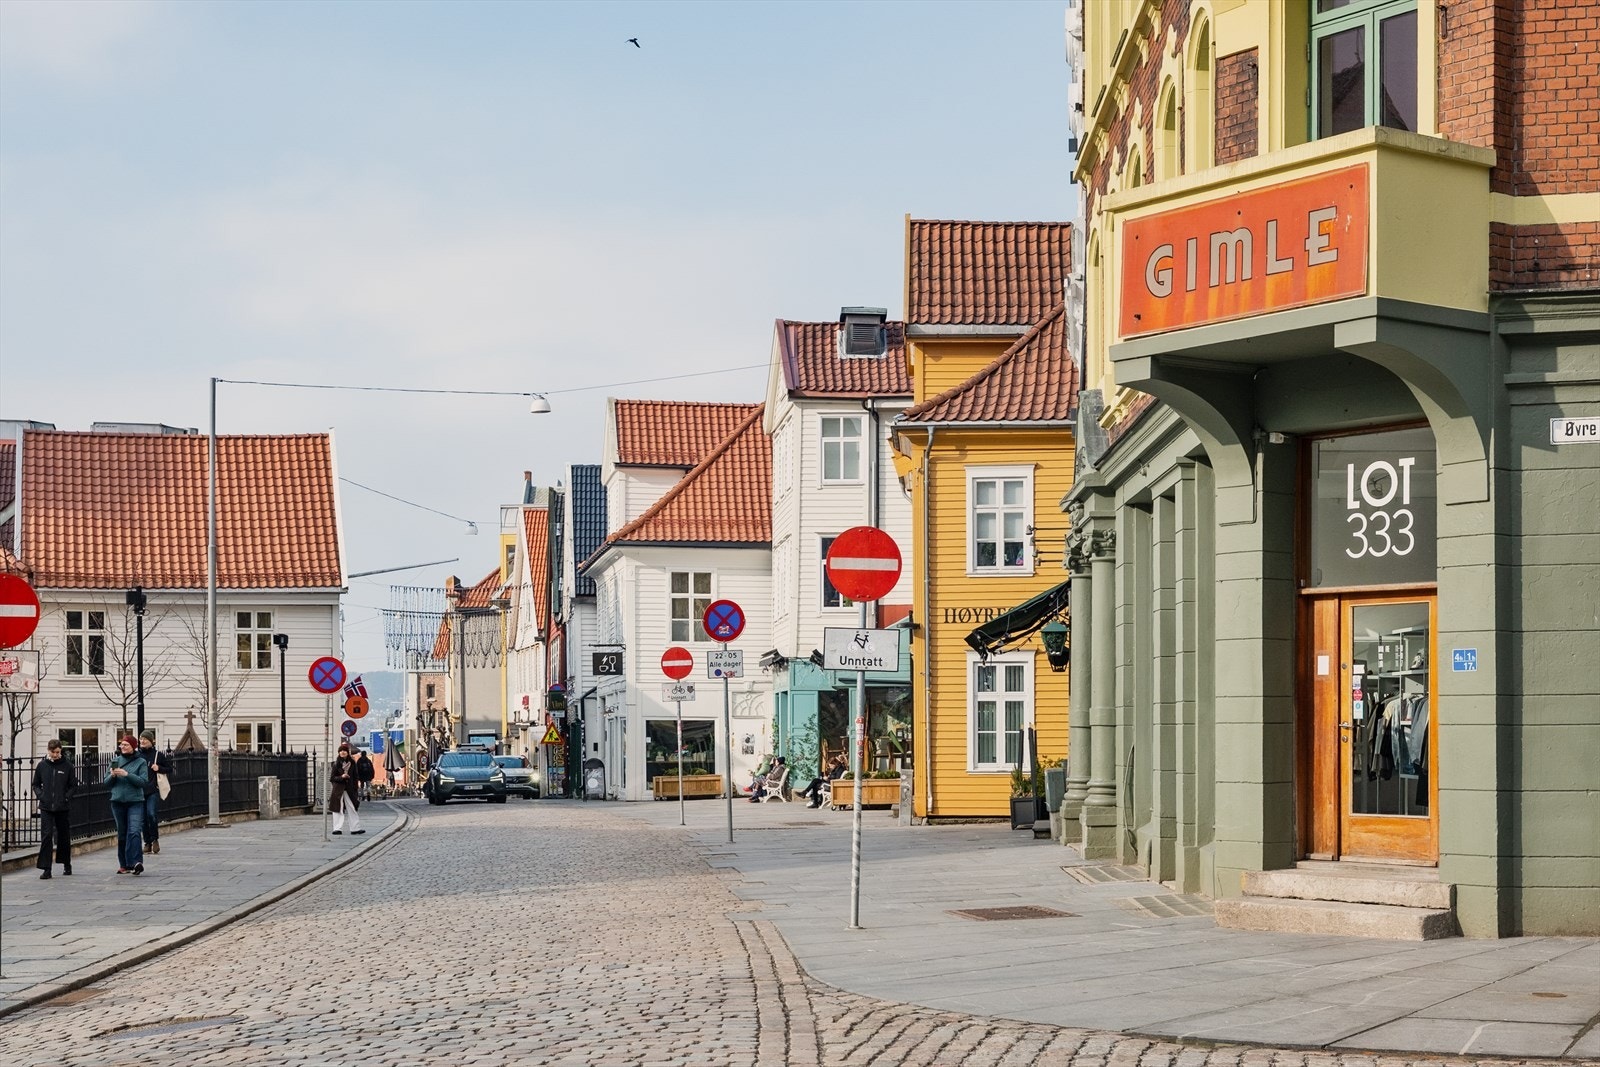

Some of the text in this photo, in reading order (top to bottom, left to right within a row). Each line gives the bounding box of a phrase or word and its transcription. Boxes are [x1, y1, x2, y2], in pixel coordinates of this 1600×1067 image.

[1145, 205, 1338, 298] GIMLE
[1565, 421, 1597, 436] Øvre
[1347, 457, 1415, 509] LOT
[1345, 508, 1415, 559] 333
[944, 608, 1014, 623] HØYRE
[839, 655, 883, 667] Unntatt
